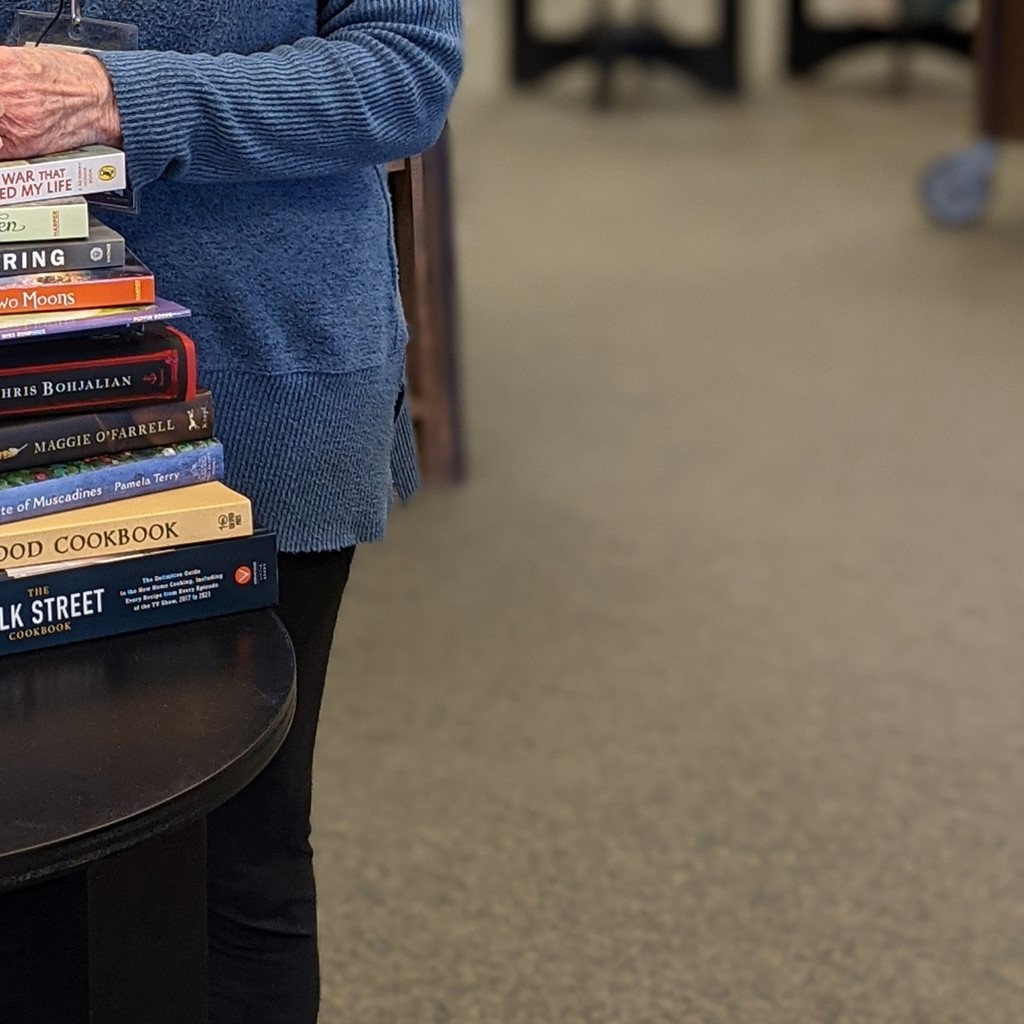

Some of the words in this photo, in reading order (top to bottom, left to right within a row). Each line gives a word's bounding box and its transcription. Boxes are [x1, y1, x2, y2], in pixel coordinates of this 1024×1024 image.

[1, 169, 36, 186] WAR
[38, 167, 67, 183] THAT
[21, 182, 44, 198] MY
[47, 178, 73, 194] LIFE
[22, 288, 76, 309] Moons
[41, 375, 133, 397] BOHJALIAN
[33, 433, 92, 455] MAGGIE
[95, 419, 176, 443] O'FARRELL
[113, 477, 152, 493] Pamela
[152, 470, 182, 489] Terry
[16, 498, 33, 515] of
[32, 485, 104, 511] Muscadines
[54, 521, 180, 556] COOKBOOK
[27, 585, 51, 598] THE
[142, 576, 154, 585] The
[30, 587, 106, 626] STREET
[151, 600, 161, 609] TV
[8, 620, 74, 642] COOKBOOK
